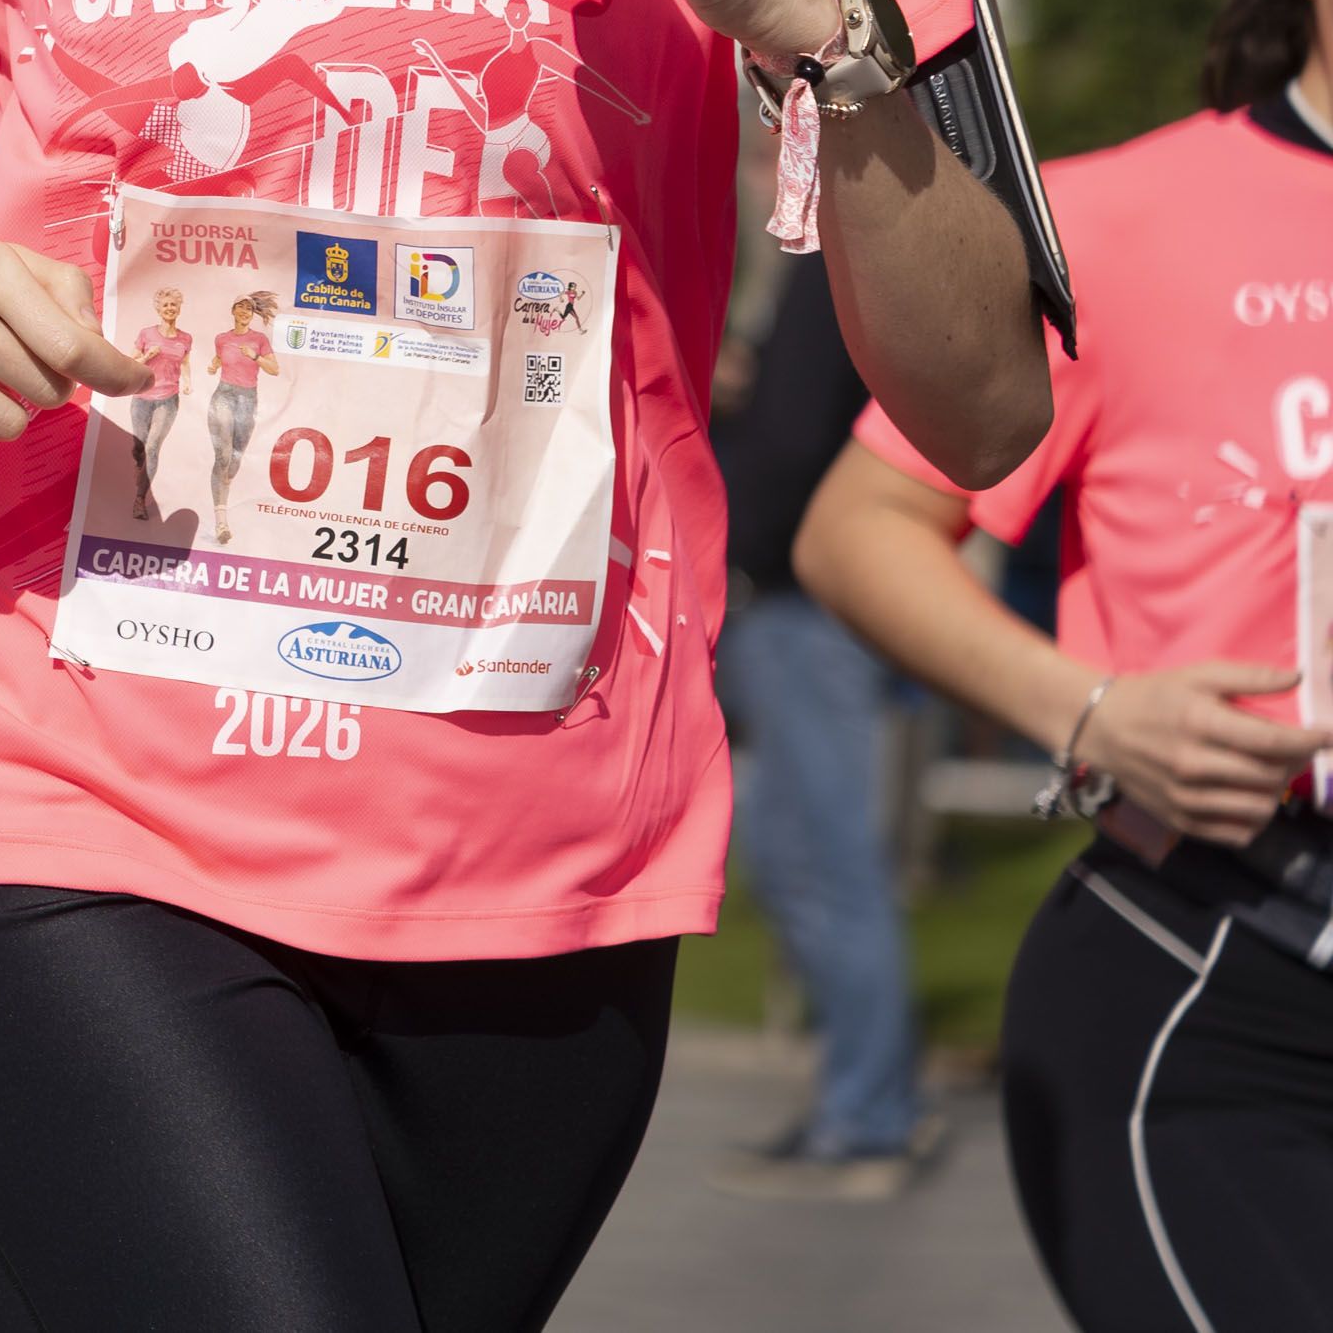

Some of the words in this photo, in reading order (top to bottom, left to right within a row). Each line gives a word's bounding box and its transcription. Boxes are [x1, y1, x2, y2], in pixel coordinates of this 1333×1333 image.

[150, 222, 175, 237] TU
[181, 224, 259, 242] DORSAL
[156, 240, 259, 270] SUMA
[306, 283, 348, 297] Cabildo
[350, 288, 364, 299] de
[300, 294, 327, 306] Gran
[330, 295, 371, 310] Canaria
[514, 298, 550, 313] Carrera
[416, 309, 462, 323] DEPORTES
[534, 313, 565, 336] Mujer
[310, 329, 364, 342] Ayuntamiento
[309, 344, 320, 352] de
[321, 344, 335, 353] Gran
[337, 346, 362, 355] Canaria
[269, 427, 473, 521] 016
[256, 504, 317, 519] TELÉFONO
[318, 511, 382, 528] VIOLENCIA
[384, 520, 400, 530] DE
[402, 521, 450, 536] GÉNERO
[311, 527, 409, 570] 2314
[92, 548, 209, 587] CARRERA
[218, 565, 251, 591] DE
[259, 570, 289, 598] LA
[299, 576, 389, 610] MUJER
[411, 589, 477, 619] GRAN
[481, 591, 579, 620] CANARIA
[117, 619, 215, 652] OYSHO
[307, 637, 347, 650] CENTRAL
[286, 637, 392, 671] ASTURIANA
[478, 659, 551, 675] Santander
[212, 688, 361, 761] 2026
